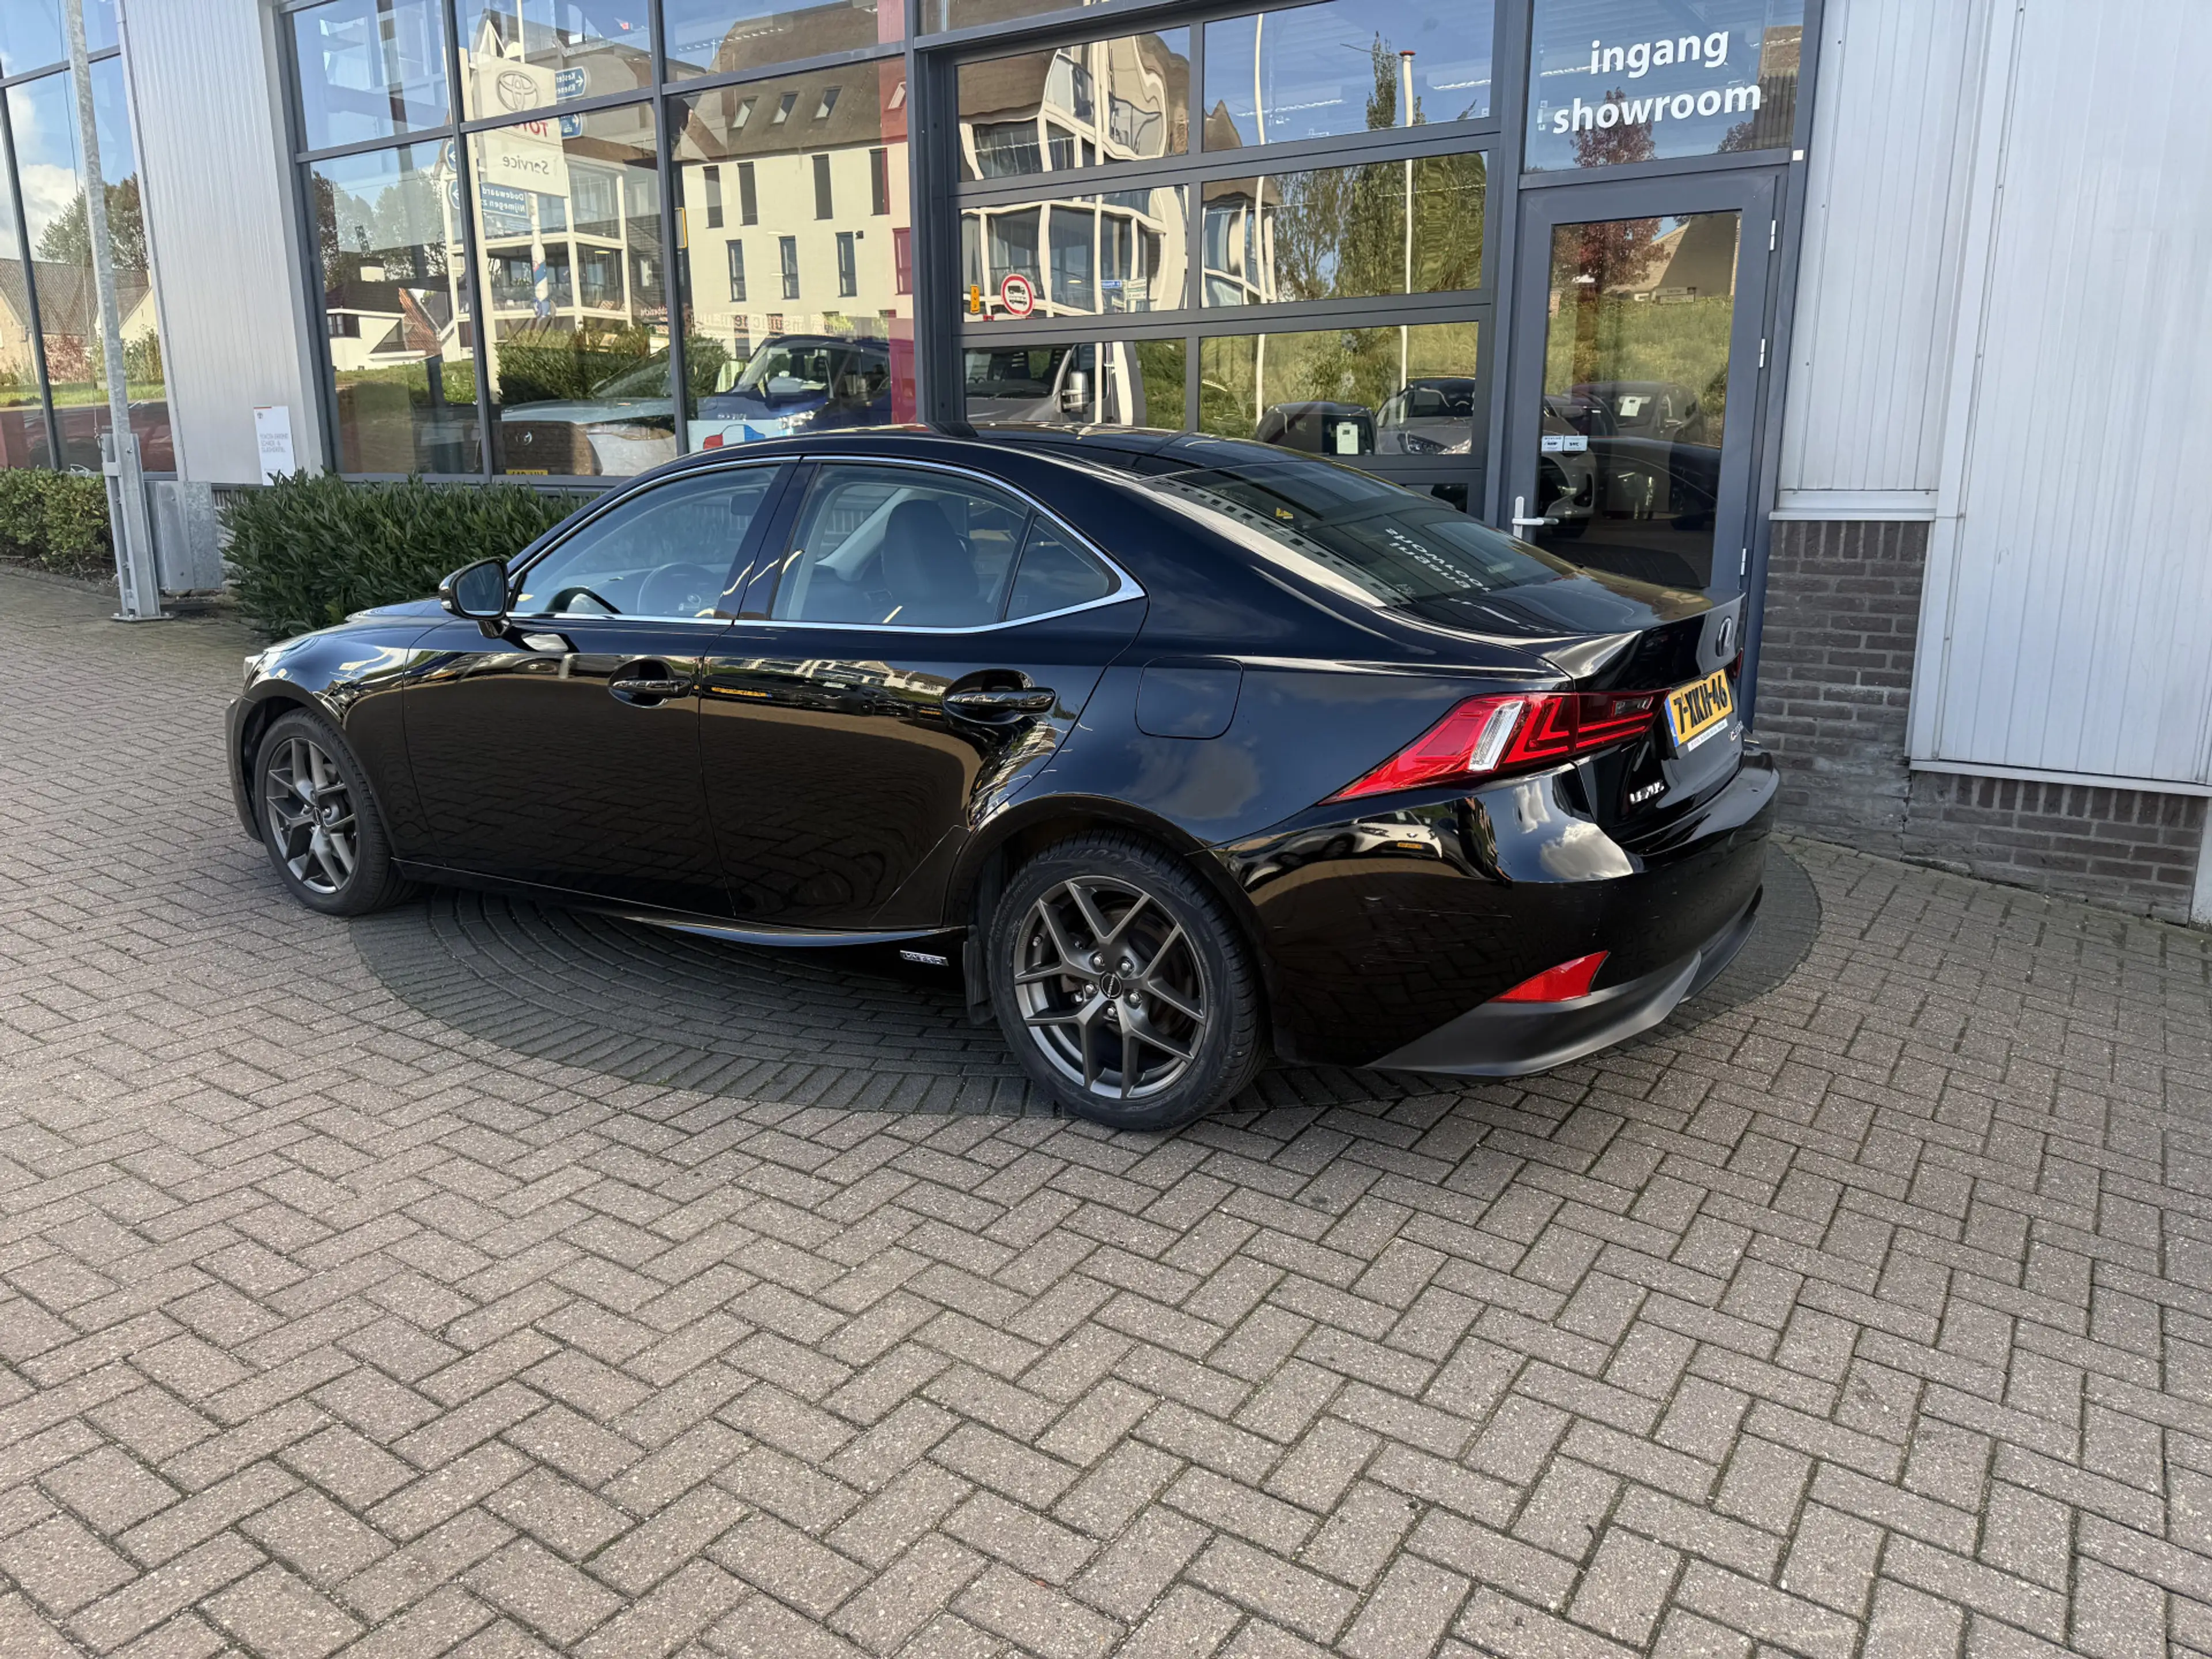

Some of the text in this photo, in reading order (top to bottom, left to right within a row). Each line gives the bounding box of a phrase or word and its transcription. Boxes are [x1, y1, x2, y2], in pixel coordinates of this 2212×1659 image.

[1590, 31, 1729, 78] ingang
[1553, 85, 1761, 133] showroom
[1673, 675, 1728, 734] 7-XKH-46
